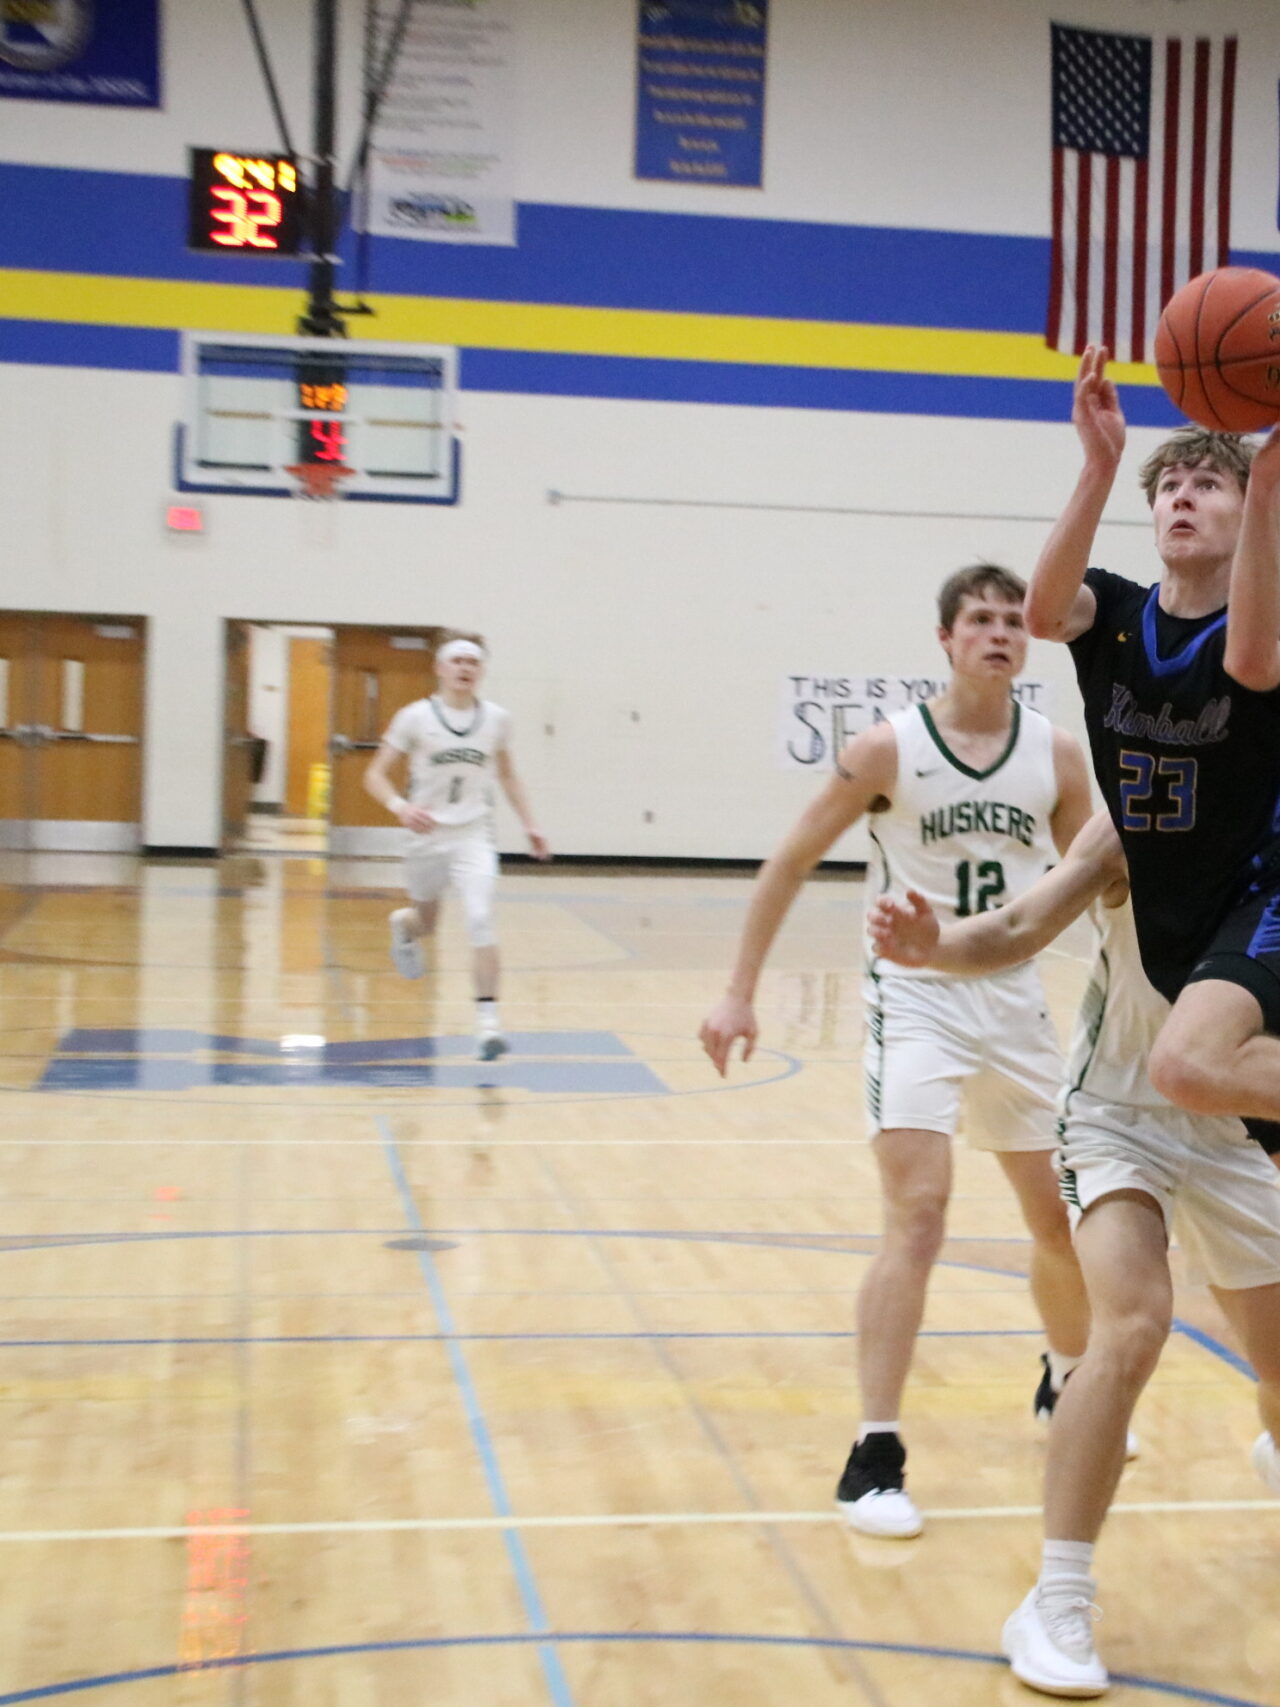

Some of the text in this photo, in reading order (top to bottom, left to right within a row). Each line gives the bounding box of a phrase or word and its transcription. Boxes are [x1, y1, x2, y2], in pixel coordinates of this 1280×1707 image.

[209, 186, 282, 248] 32
[788, 677, 851, 698] THIS
[866, 678, 887, 698] IS
[1104, 682, 1232, 746] Kimball
[1119, 749, 1198, 832] 23
[920, 801, 1036, 847] HUSKERS
[955, 860, 1005, 918] 12
